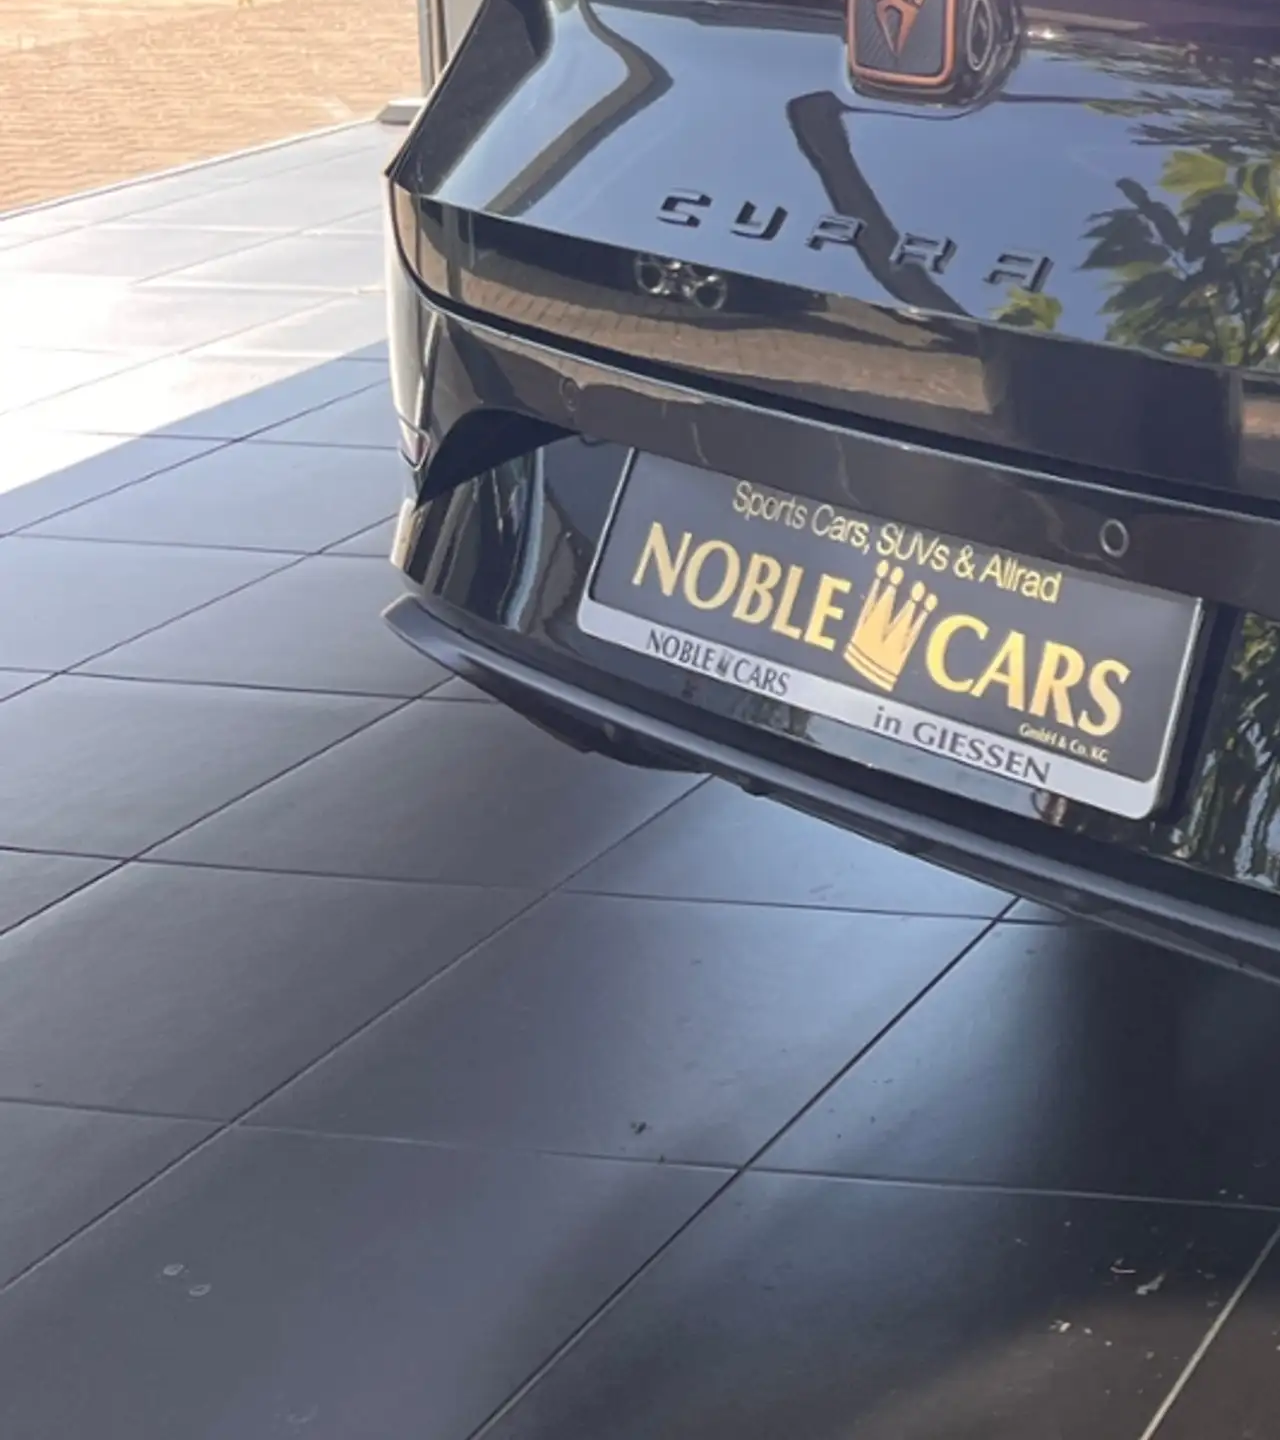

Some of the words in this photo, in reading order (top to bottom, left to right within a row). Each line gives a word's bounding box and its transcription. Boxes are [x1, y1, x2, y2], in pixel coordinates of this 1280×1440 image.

[731, 479, 808, 530] Sports
[810, 503, 871, 555] Cars,
[875, 521, 951, 573] SUVs
[952, 544, 977, 582] &
[978, 553, 1063, 605] Allrad
[631, 520, 853, 652] NOBLE
[924, 613, 1132, 737] CARS
[646, 628, 716, 672] NOBLE
[732, 657, 792, 697] CARS
[872, 705, 902, 735] in
[912, 721, 1052, 784] GIESSEN
